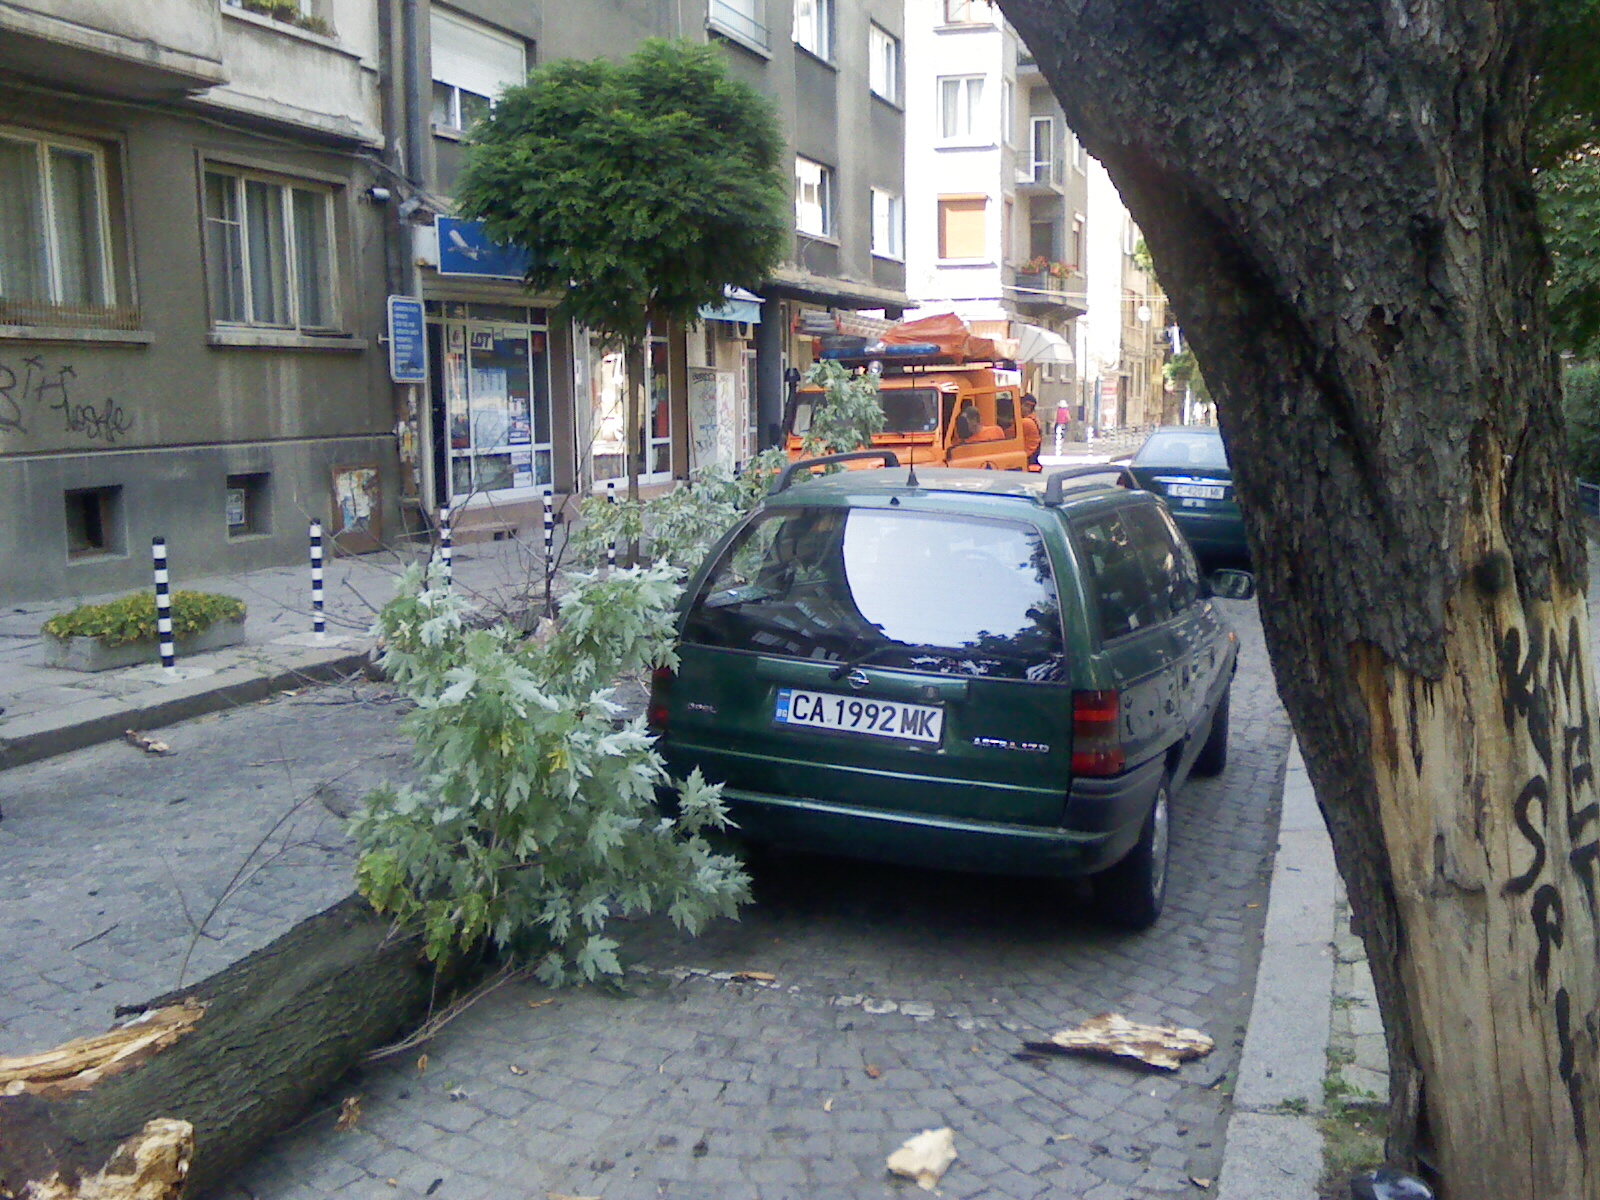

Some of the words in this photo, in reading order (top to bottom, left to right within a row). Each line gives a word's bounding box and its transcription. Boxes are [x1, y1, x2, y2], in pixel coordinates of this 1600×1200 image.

[471, 332, 491, 349] LOT
[836, 699, 896, 733] 1992
[900, 708, 937, 738] MK
